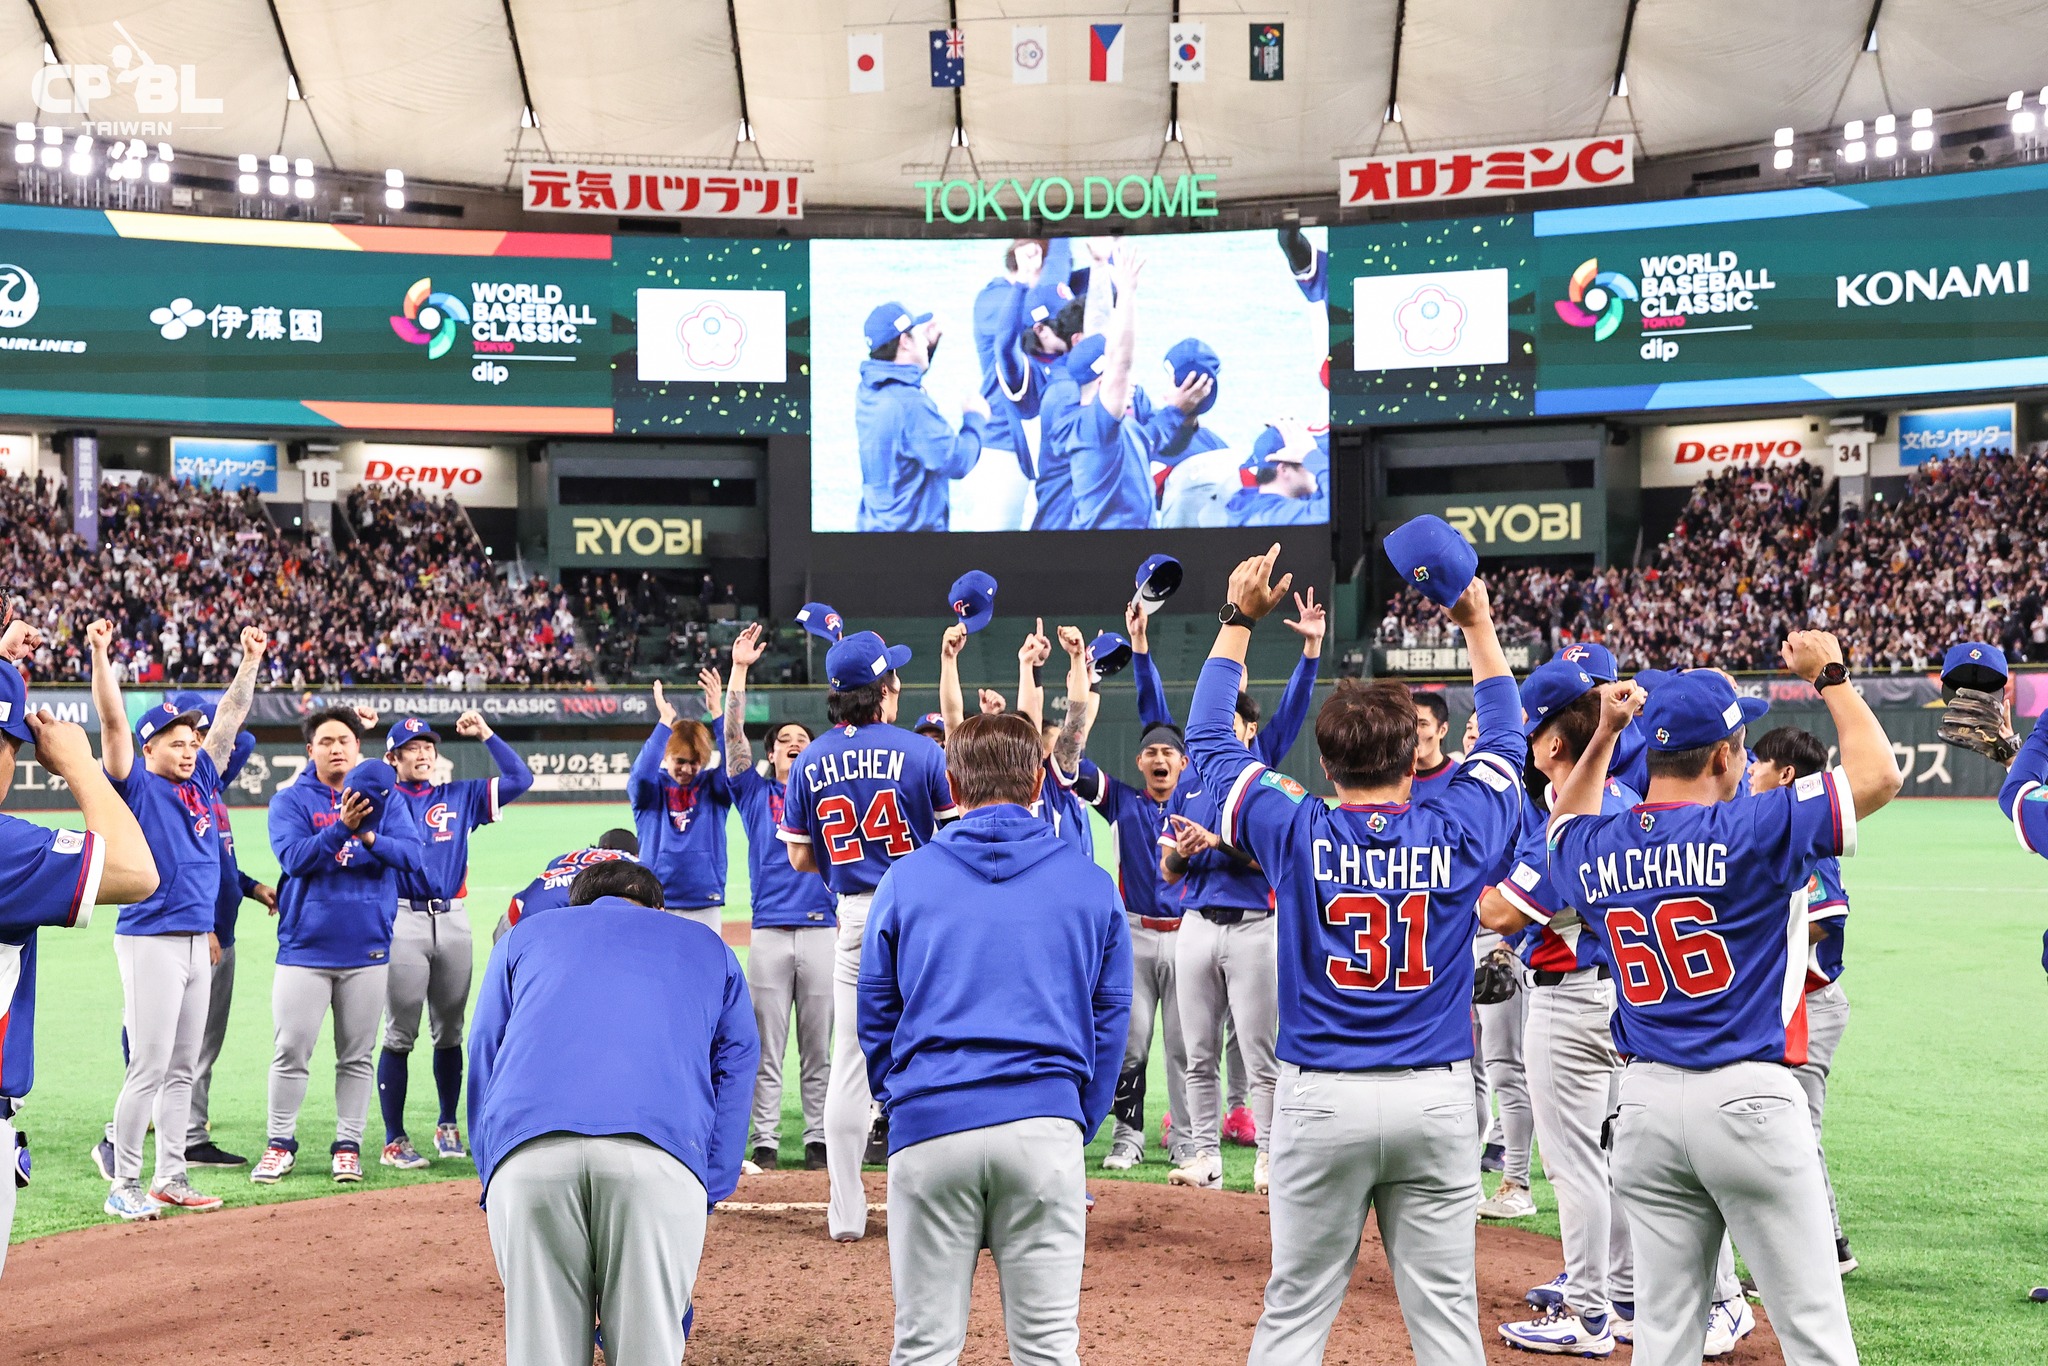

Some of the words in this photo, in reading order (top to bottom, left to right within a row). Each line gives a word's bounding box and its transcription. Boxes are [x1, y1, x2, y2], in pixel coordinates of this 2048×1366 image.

[1349, 139, 1625, 202] オロナミンC
[914, 175, 1075, 224] TOKYO
[1084, 173, 1219, 220] DOME
[1640, 250, 1738, 278] WORLD
[471, 282, 563, 304] WORLD
[1641, 268, 1776, 299] BASEBALL
[1836, 259, 2029, 308] KONAMI
[206, 303, 324, 344] 伊藤園
[472, 302, 598, 325] BASEBALL
[1641, 315, 1687, 330] TOKYO
[0, 336, 87, 354] AIRLINES
[472, 341, 516, 353] TOKYO
[1640, 337, 1680, 362] dip
[471, 361, 509, 386] dip
[1674, 440, 1803, 465] Denyo
[1839, 445, 1861, 463] 34
[312, 471, 330, 487] 16
[364, 460, 483, 489] Denyo
[572, 517, 702, 556] RYOBI
[1445, 501, 1582, 544] RYOBI
[393, 698, 482, 714] BASEBALL
[483, 698, 557, 714] CLASSIC
[560, 697, 618, 714] TOKYO
[622, 696, 648, 714] dip
[528, 752, 631, 775] 守りの名手
[804, 749, 905, 793] C.H.CHEN
[816, 788, 915, 866] 24
[1312, 838, 1451, 890] C.H.CHEN
[1578, 842, 1728, 905] C.M.CHANG
[1325, 891, 1434, 992] 31
[1604, 896, 1736, 1007] 66
